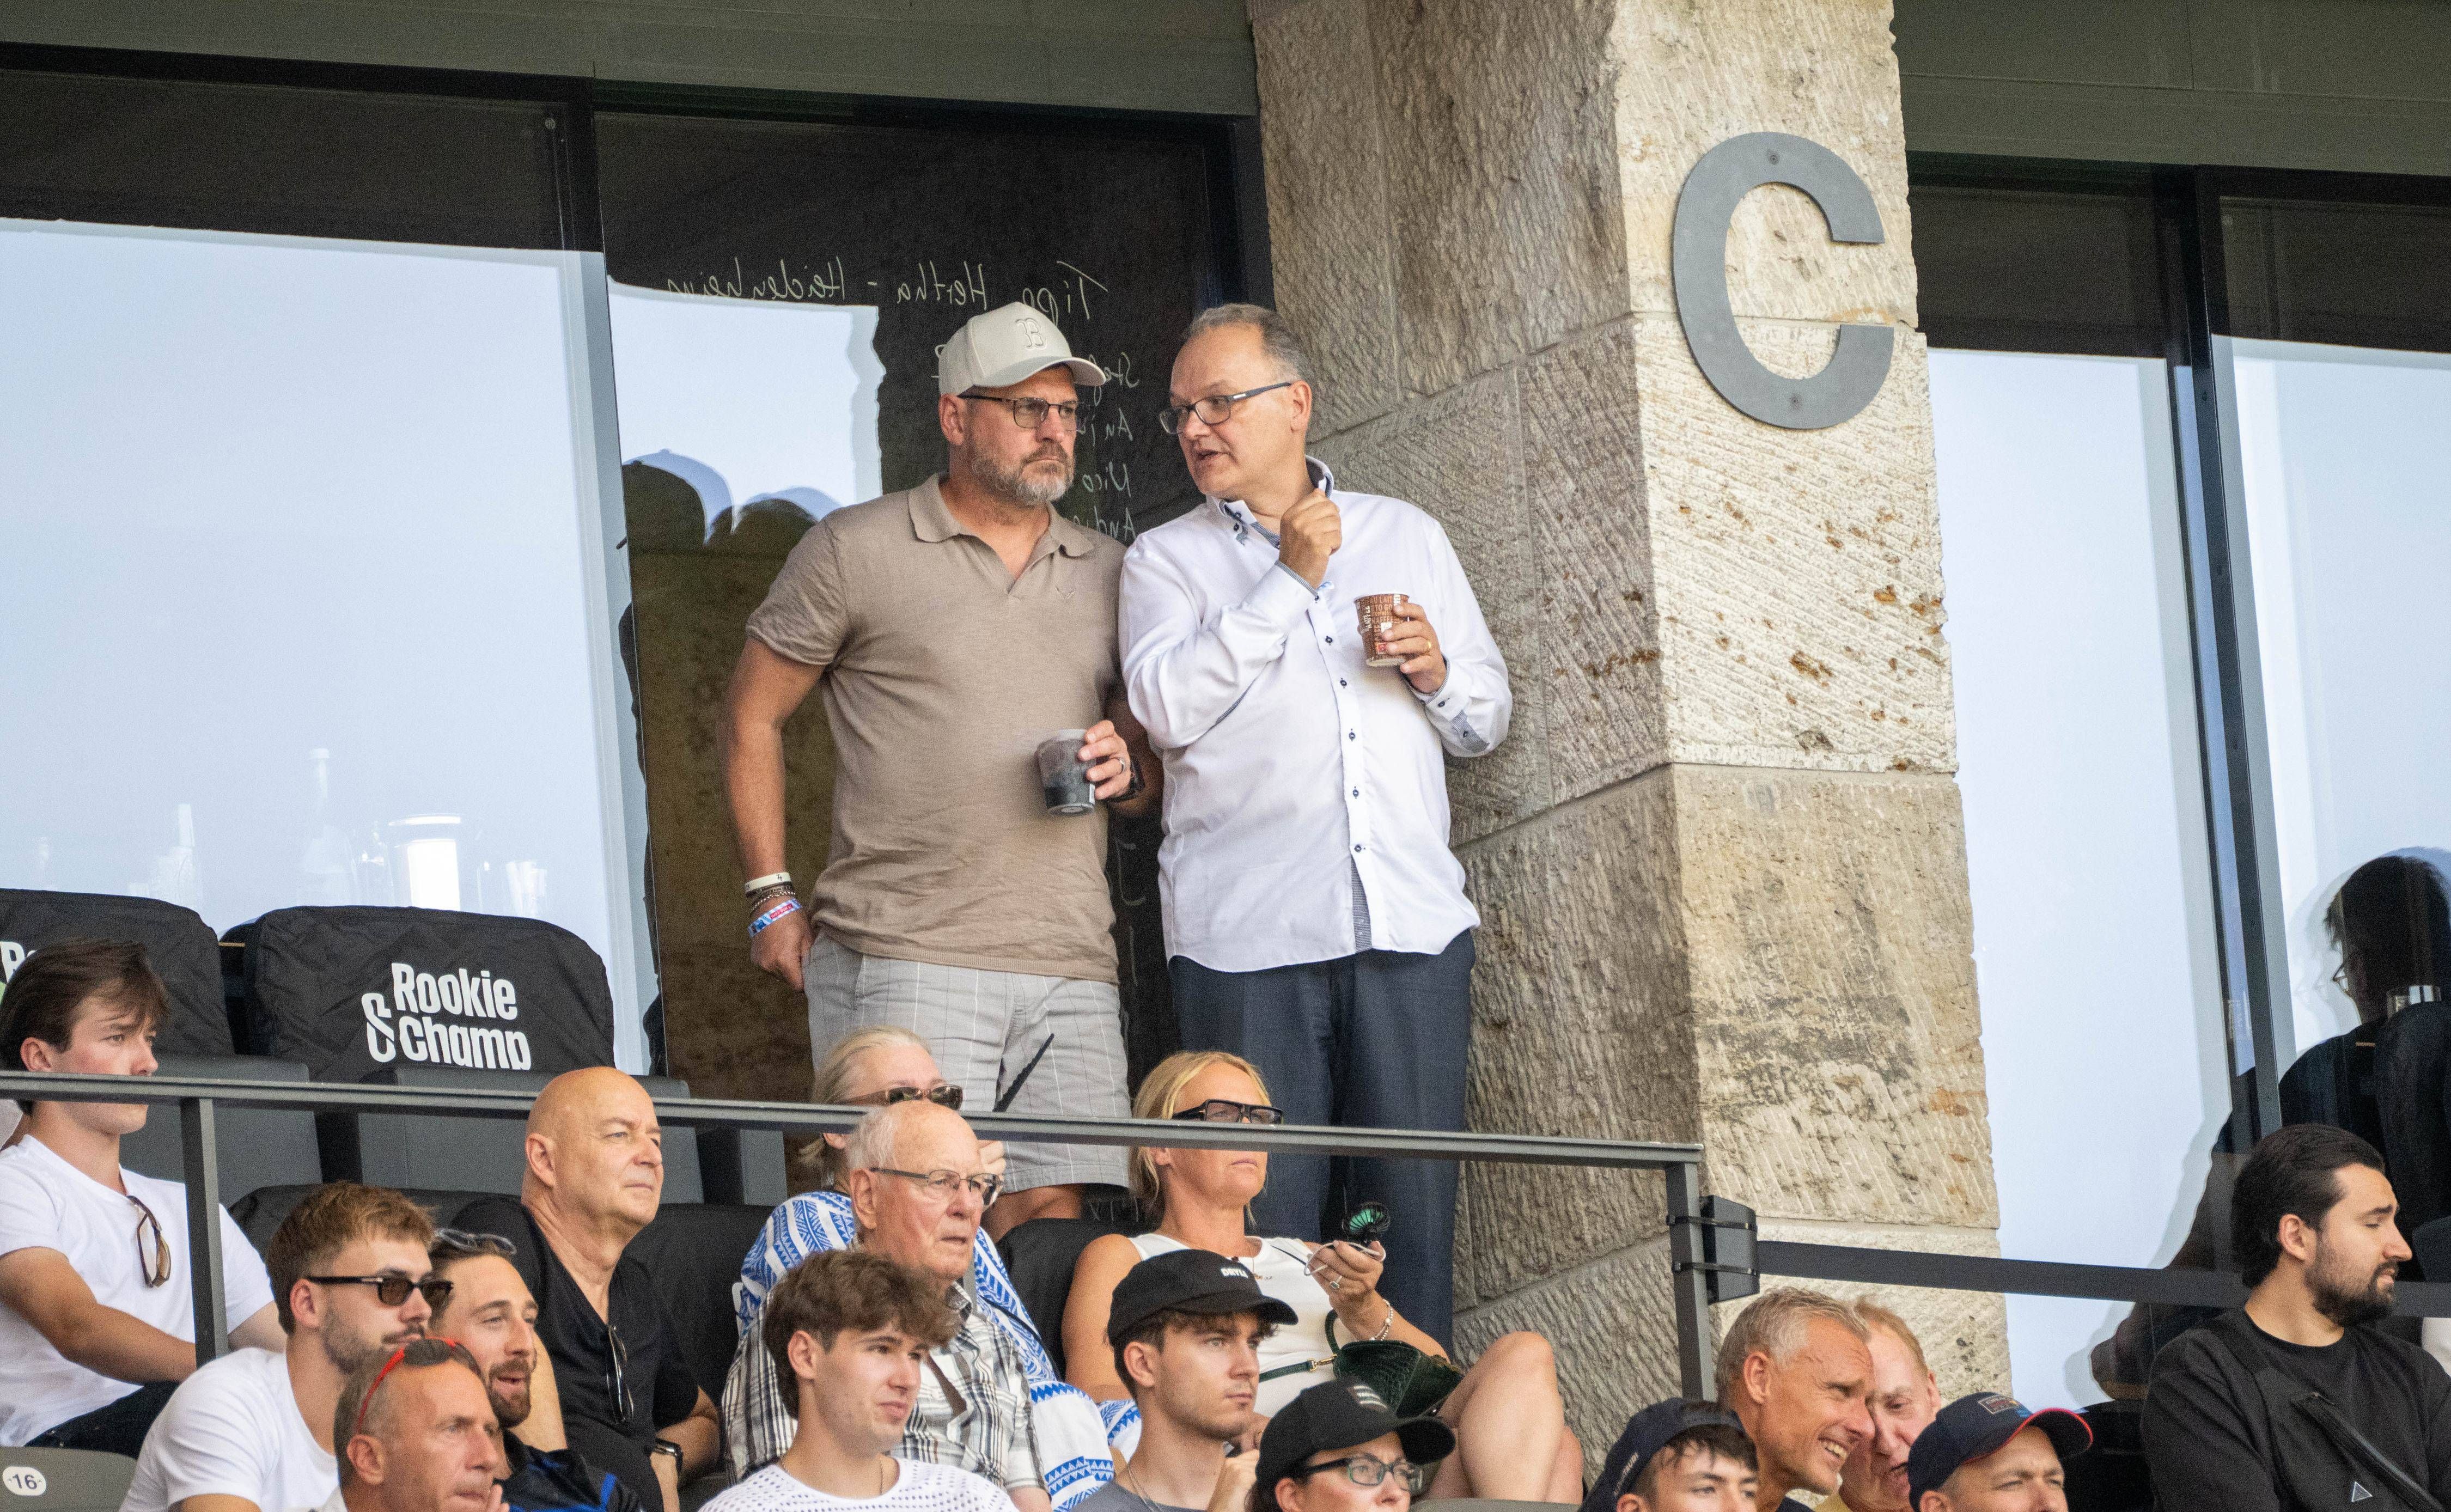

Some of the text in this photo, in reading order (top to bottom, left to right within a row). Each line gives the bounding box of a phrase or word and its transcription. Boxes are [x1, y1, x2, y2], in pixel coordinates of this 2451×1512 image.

[1673, 131, 1894, 430] C
[1015, 318, 1045, 349] B
[392, 962, 518, 1020] Rookie
[399, 1016, 532, 1071] Champ
[13, 1474, 38, 1490] 16
